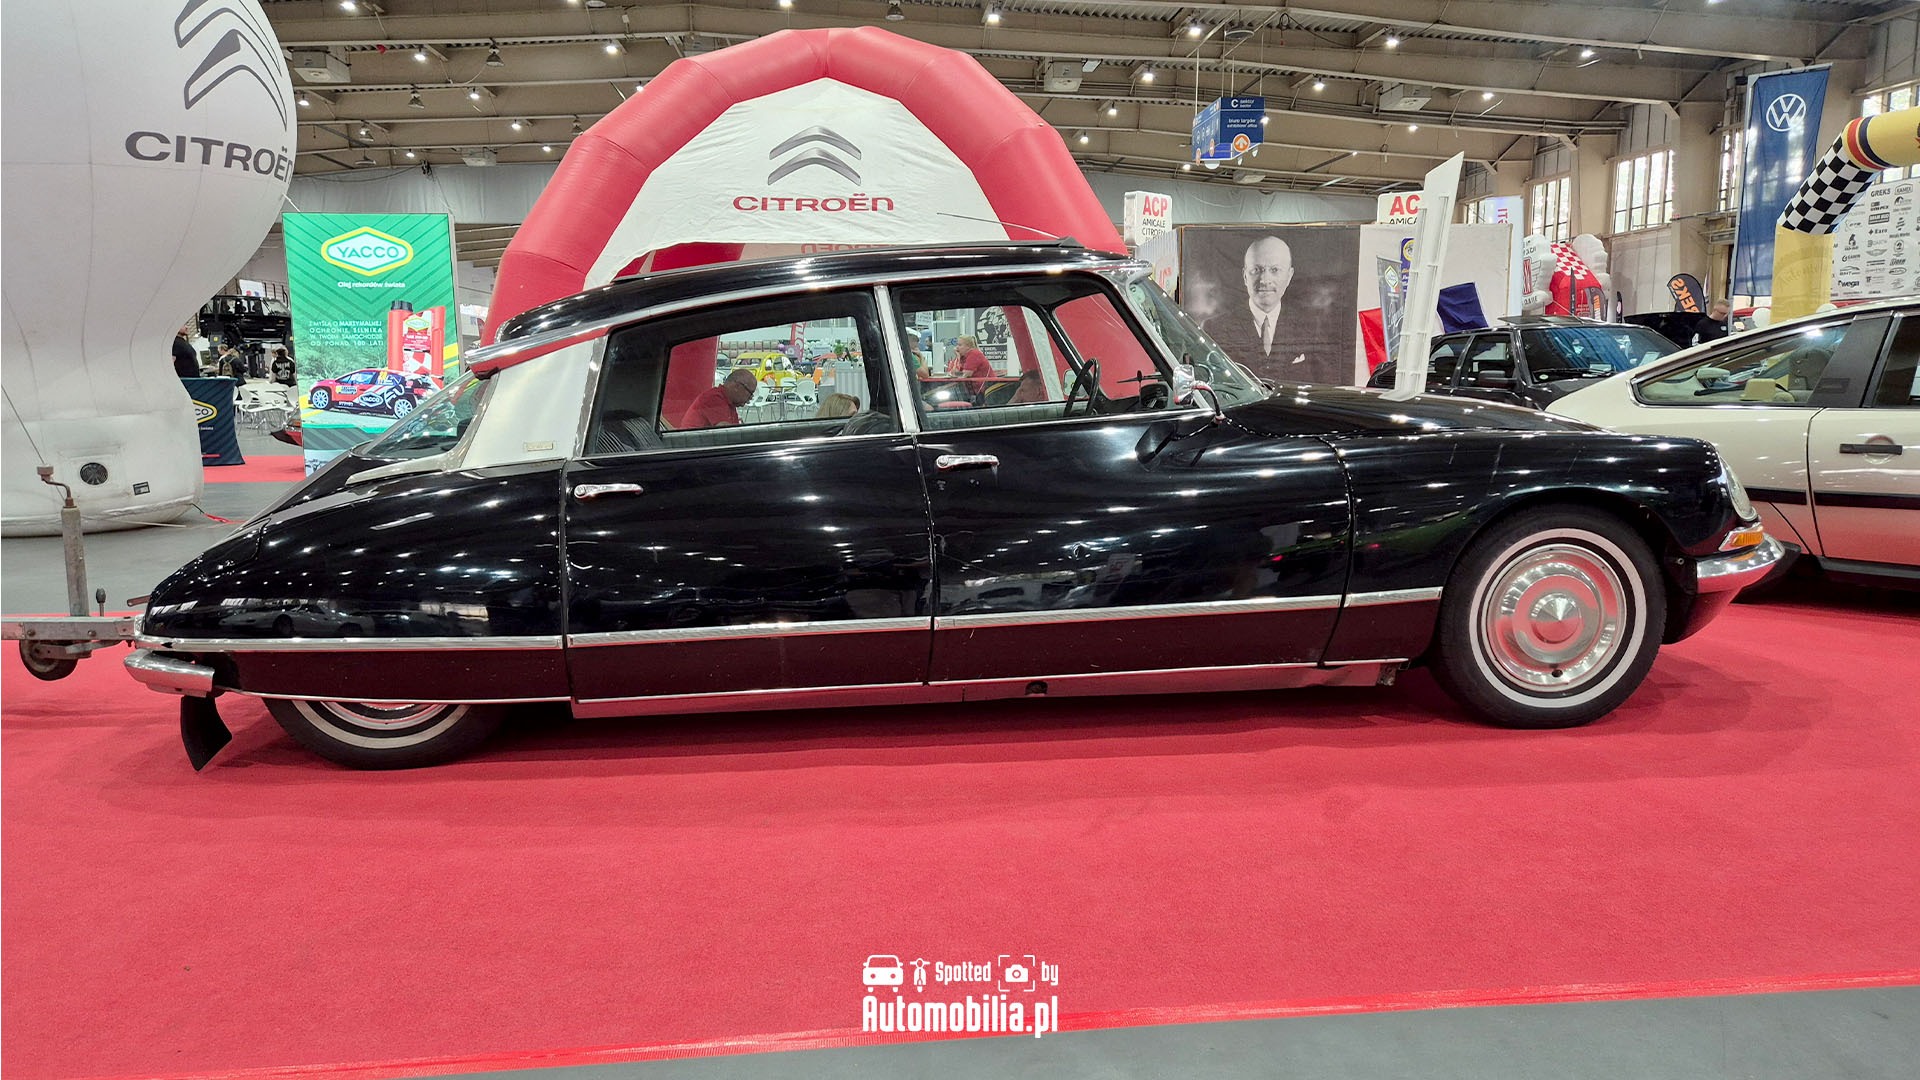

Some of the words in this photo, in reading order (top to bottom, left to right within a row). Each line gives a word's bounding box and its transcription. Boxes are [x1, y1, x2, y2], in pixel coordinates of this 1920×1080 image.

[1231, 99, 1238, 108] C
[1871, 188, 1890, 197] GREKS
[733, 193, 894, 212] CITROËN
[1143, 195, 1167, 217] ACP
[1390, 194, 1420, 215] AC
[1142, 218, 1165, 228] AMICALE
[338, 246, 399, 258] YACCO
